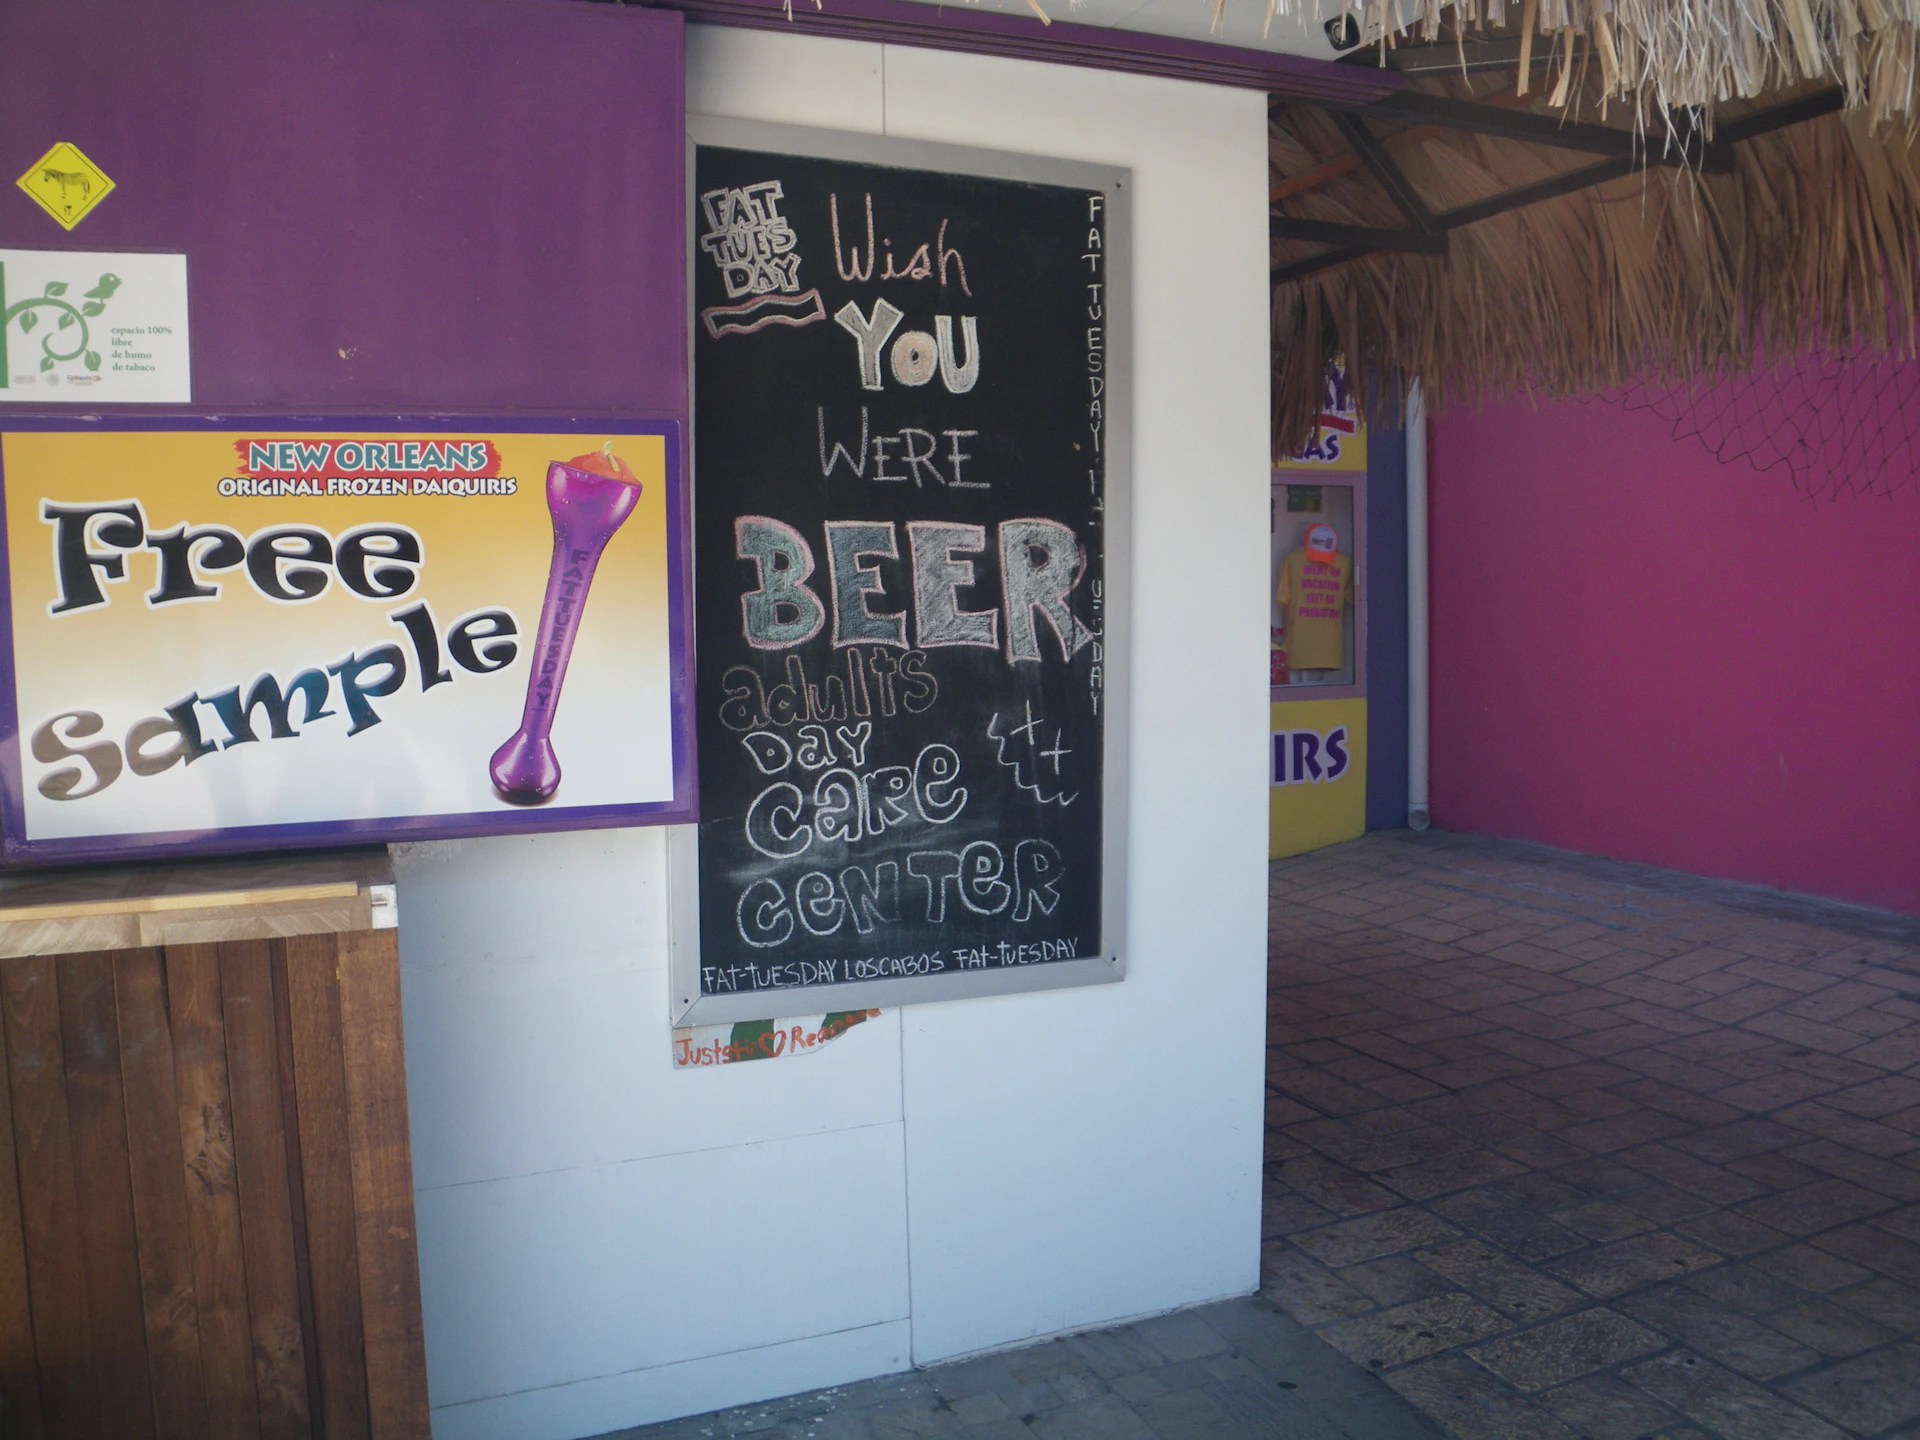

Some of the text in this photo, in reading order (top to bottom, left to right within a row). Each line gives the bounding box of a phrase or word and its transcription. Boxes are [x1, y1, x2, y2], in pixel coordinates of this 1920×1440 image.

[700, 180, 785, 234] FAT
[829, 192, 973, 297] Wish
[723, 252, 802, 299] DAY
[111, 326, 173, 336] espacio 100%
[111, 337, 133, 347] libre
[112, 351, 152, 360] de humo
[834, 297, 981, 394] YOU
[112, 362, 156, 372] de tabaco
[1087, 283, 1104, 452] TUESDAY
[249, 441, 489, 472] NEW ORLEANS
[817, 406, 991, 488] WERE
[217, 478, 518, 498] ORIGINAL FROZEN DAIQUIRIS
[41, 498, 425, 615] Free
[562, 549, 590, 597] FAT
[734, 515, 1094, 668] BEER
[30, 600, 521, 803] Sample
[719, 647, 939, 731] adults
